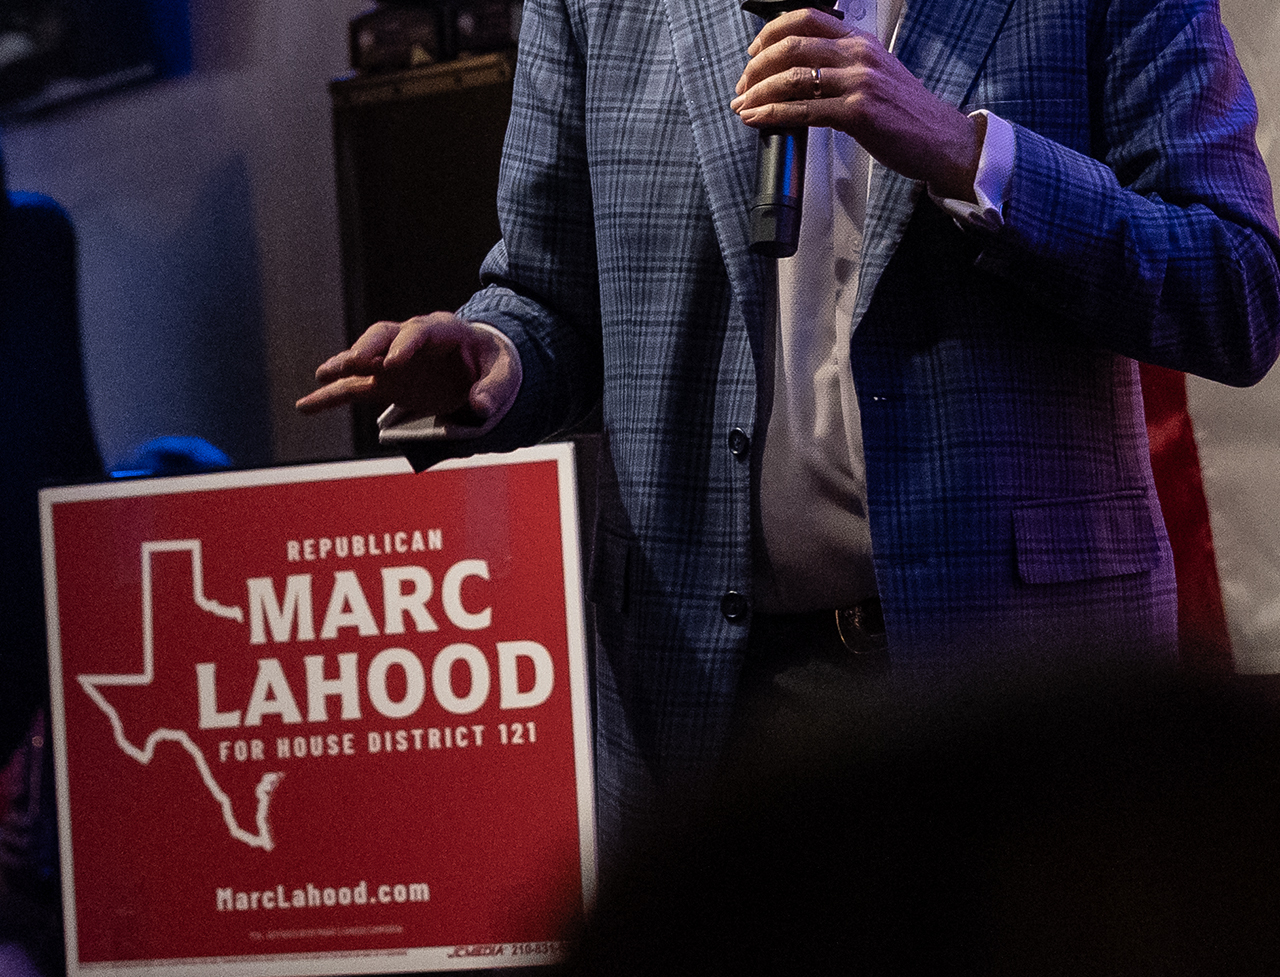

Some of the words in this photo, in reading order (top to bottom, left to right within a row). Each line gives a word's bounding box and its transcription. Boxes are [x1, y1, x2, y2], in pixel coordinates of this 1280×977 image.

[287, 528, 443, 562] REPUBLICAN
[246, 559, 493, 645] MARC
[196, 640, 555, 730] LAHOOD
[219, 740, 265, 762] FOR
[277, 733, 355, 759] HOUSE
[368, 725, 485, 754] DISTRICT
[498, 722, 537, 745] 121
[216, 880, 430, 911] MarcLahood.com
